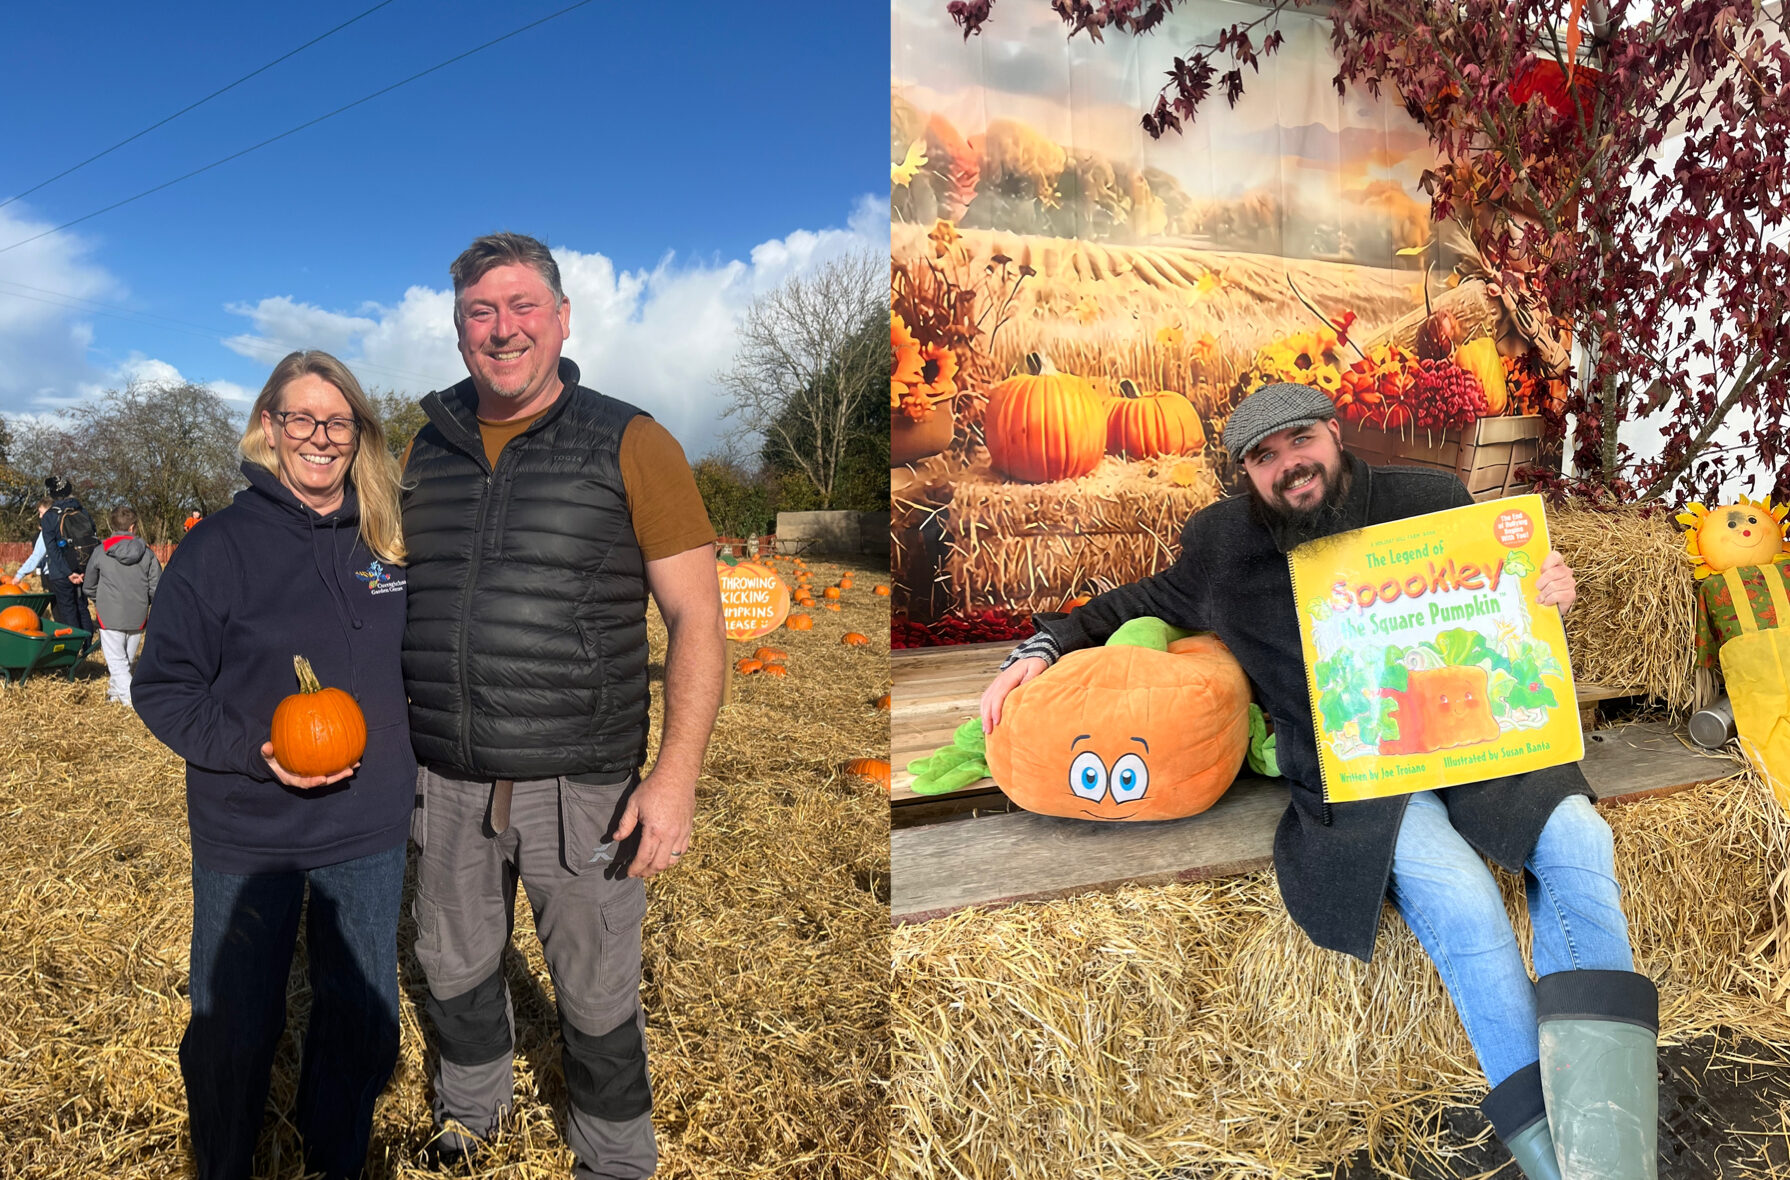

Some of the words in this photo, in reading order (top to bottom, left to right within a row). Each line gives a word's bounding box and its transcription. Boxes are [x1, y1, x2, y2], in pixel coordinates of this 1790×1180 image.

[1366, 552, 1386, 569] The
[1389, 544, 1430, 566] Legend
[1433, 540, 1444, 556] of
[720, 576, 776, 590] THROWING
[1330, 558, 1504, 616] Spookley
[720, 591, 770, 604] KICKING
[726, 620, 757, 630] LEASE
[1340, 617, 1366, 640] the
[1370, 612, 1425, 635] Square
[1428, 594, 1502, 624] Pumpkin
[1443, 752, 1486, 768] Illustrated
[1488, 750, 1499, 760] by
[1500, 748, 1524, 758] Susan
[1526, 742, 1550, 754] Banta
[1340, 772, 1367, 783] Written
[1368, 770, 1379, 780] by
[1381, 768, 1394, 779] Joe
[1396, 764, 1426, 775] Troiano
